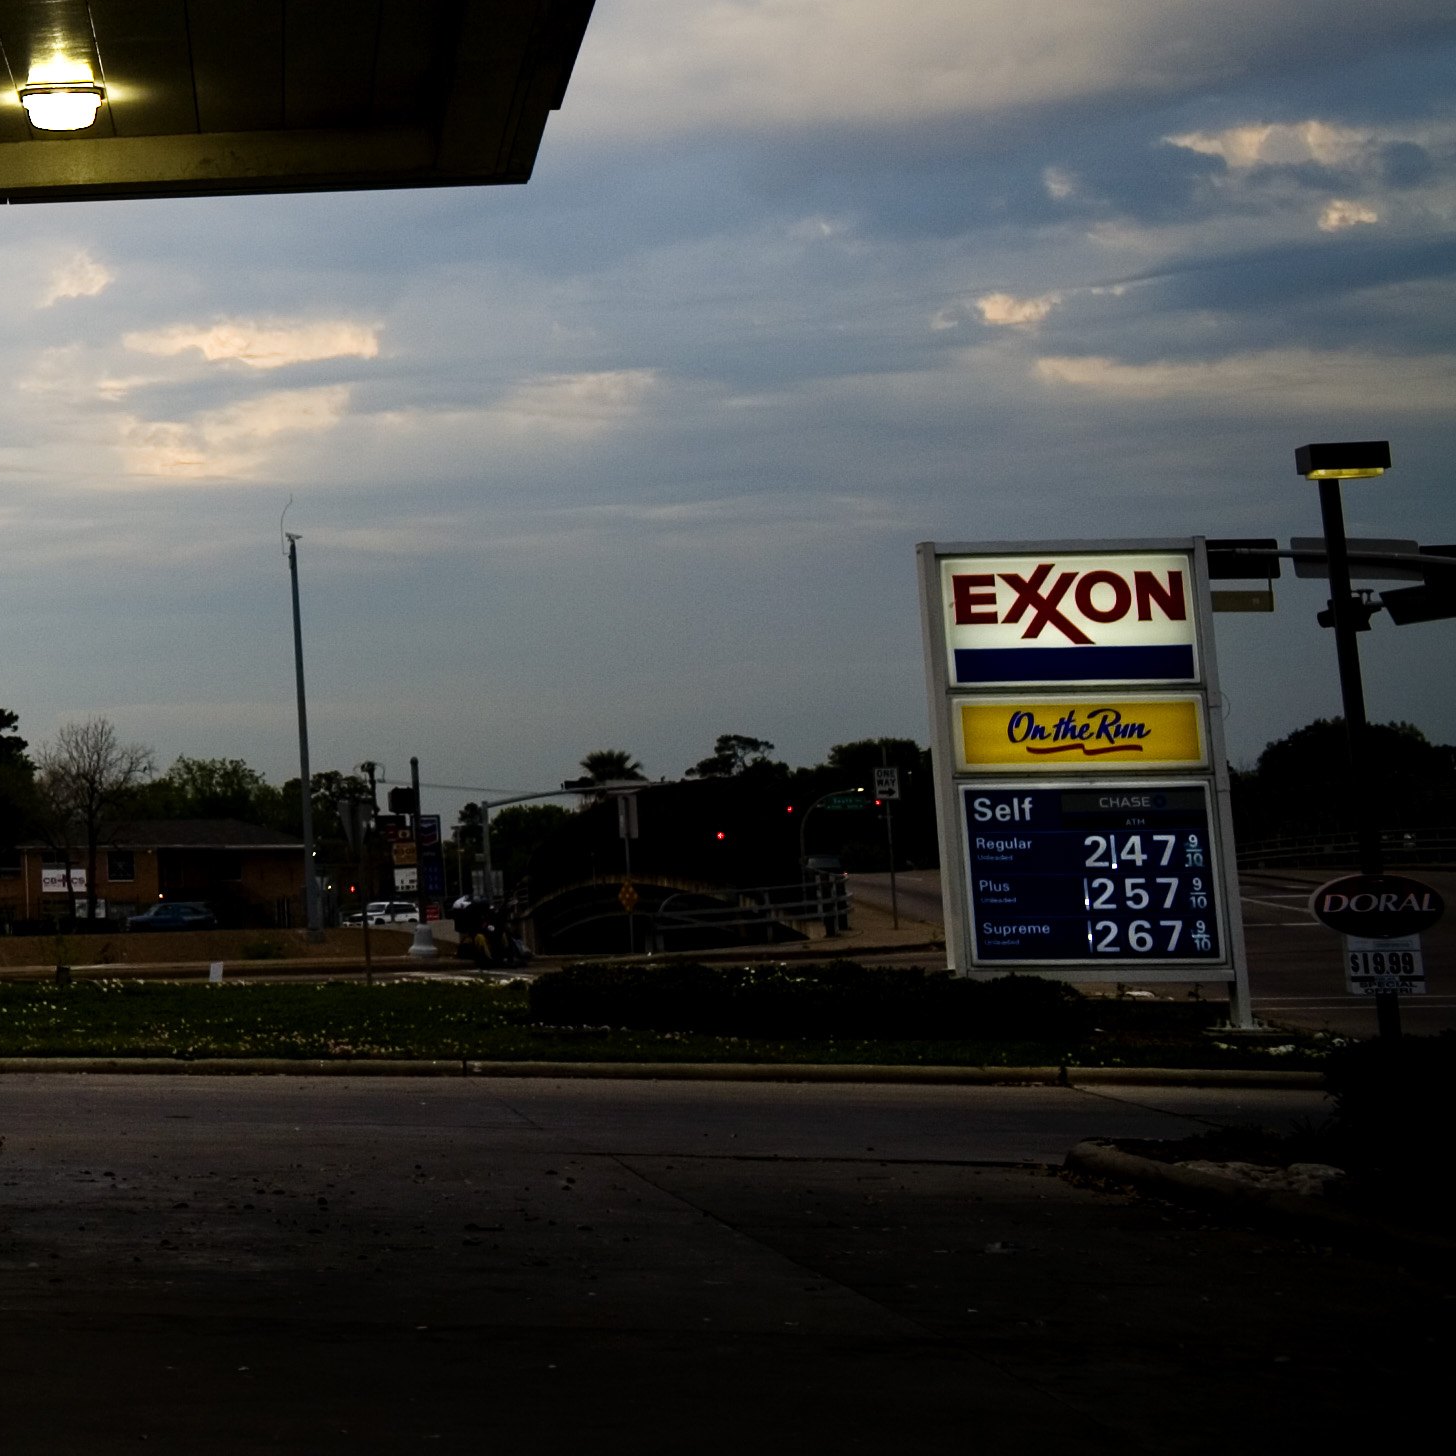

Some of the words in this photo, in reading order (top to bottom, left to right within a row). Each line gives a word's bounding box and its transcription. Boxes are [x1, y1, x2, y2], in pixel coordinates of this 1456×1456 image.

[952, 564, 1187, 644] EXXON
[1007, 711, 1051, 743] On
[1052, 709, 1094, 741] the
[1087, 708, 1151, 743] Run
[876, 769, 895, 777] ONE
[876, 778, 896, 786] WAY
[973, 796, 1033, 822] Self
[1098, 796, 1151, 808] CHASE
[1124, 818, 1146, 827] ATM
[975, 837, 1032, 852] Regular
[979, 879, 1010, 892] Plus
[1090, 877, 1180, 910] 257
[1322, 893, 1437, 913] DORAL
[982, 921, 1051, 936] Supreme
[1094, 919, 1183, 953] 267
[1350, 952, 1415, 975] $19.99
[1359, 981, 1418, 989] SPECIAL
